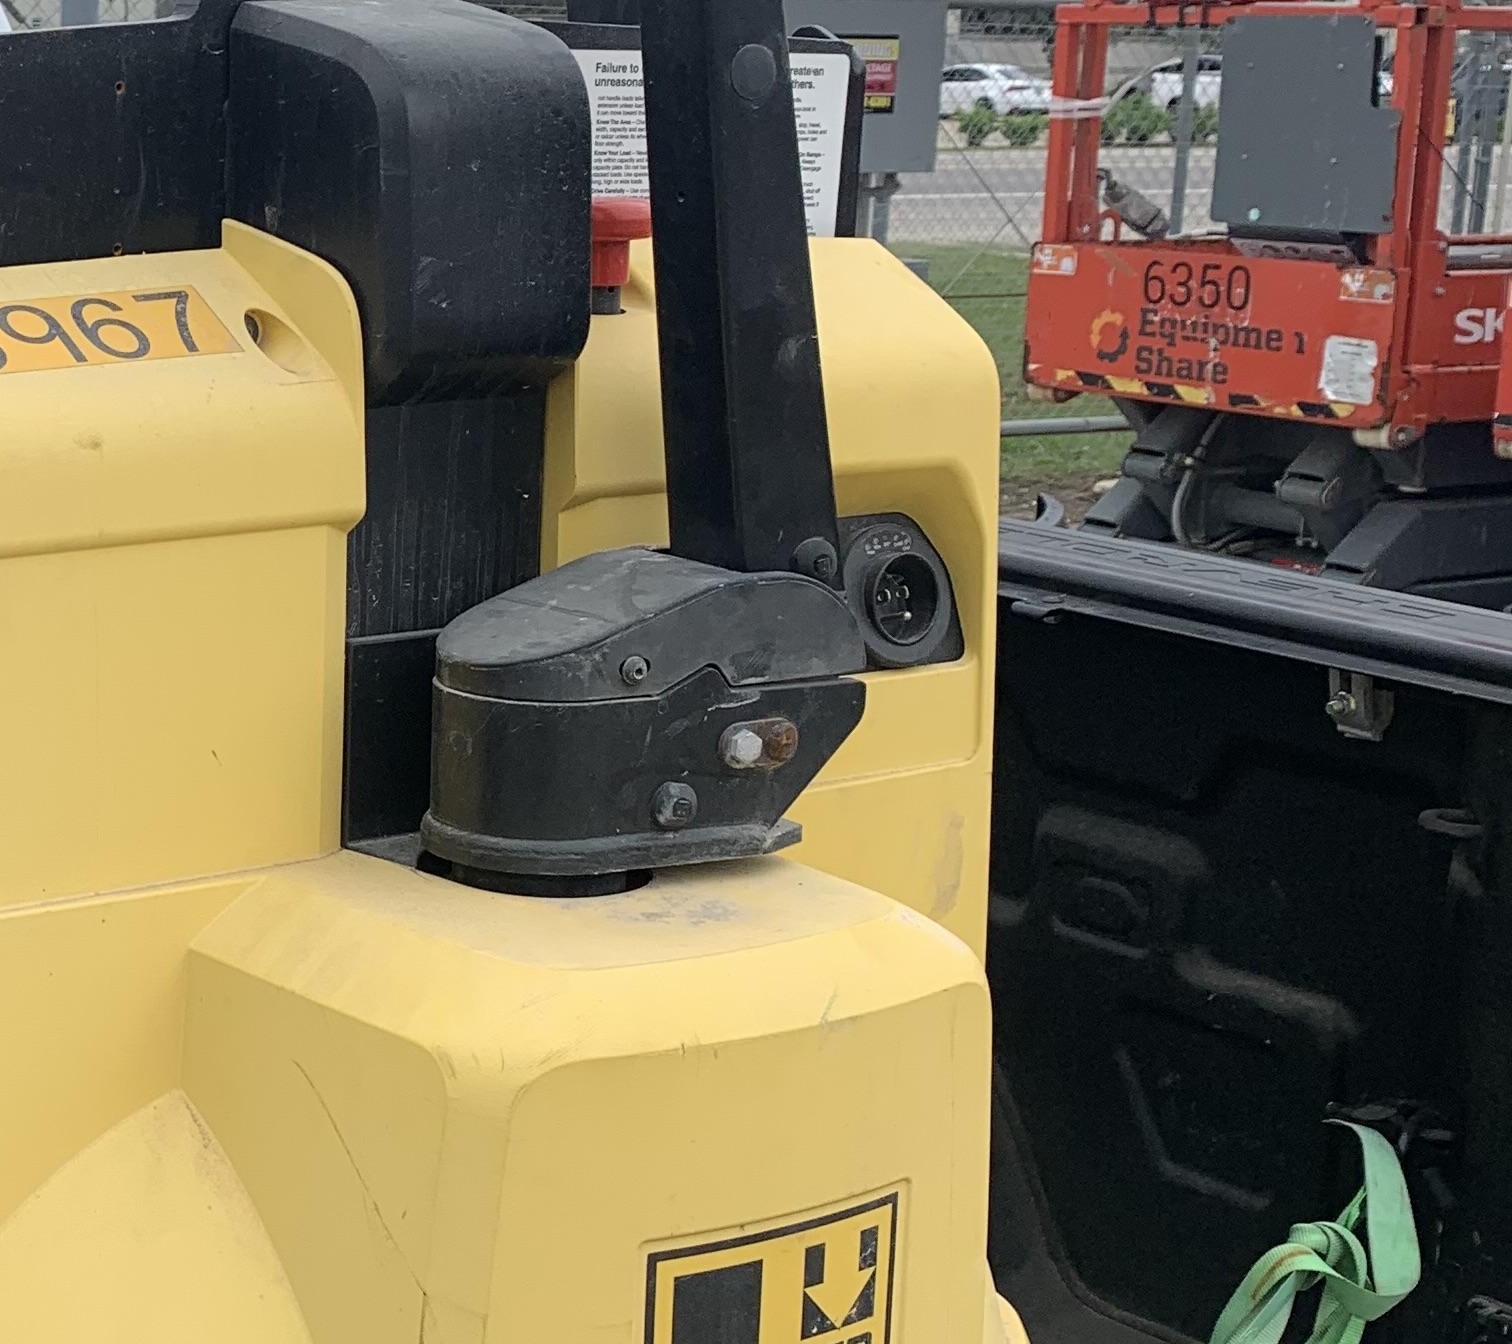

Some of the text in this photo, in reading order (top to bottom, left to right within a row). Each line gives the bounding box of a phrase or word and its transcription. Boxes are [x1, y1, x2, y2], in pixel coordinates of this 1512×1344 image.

[594, 76, 816, 90] unreasona thers.
[595, 61, 628, 74] Failure
[629, 62, 640, 74] to
[789, 67, 812, 77] reate
[1143, 258, 1253, 312] 6350
[1134, 345, 1229, 386] Share
